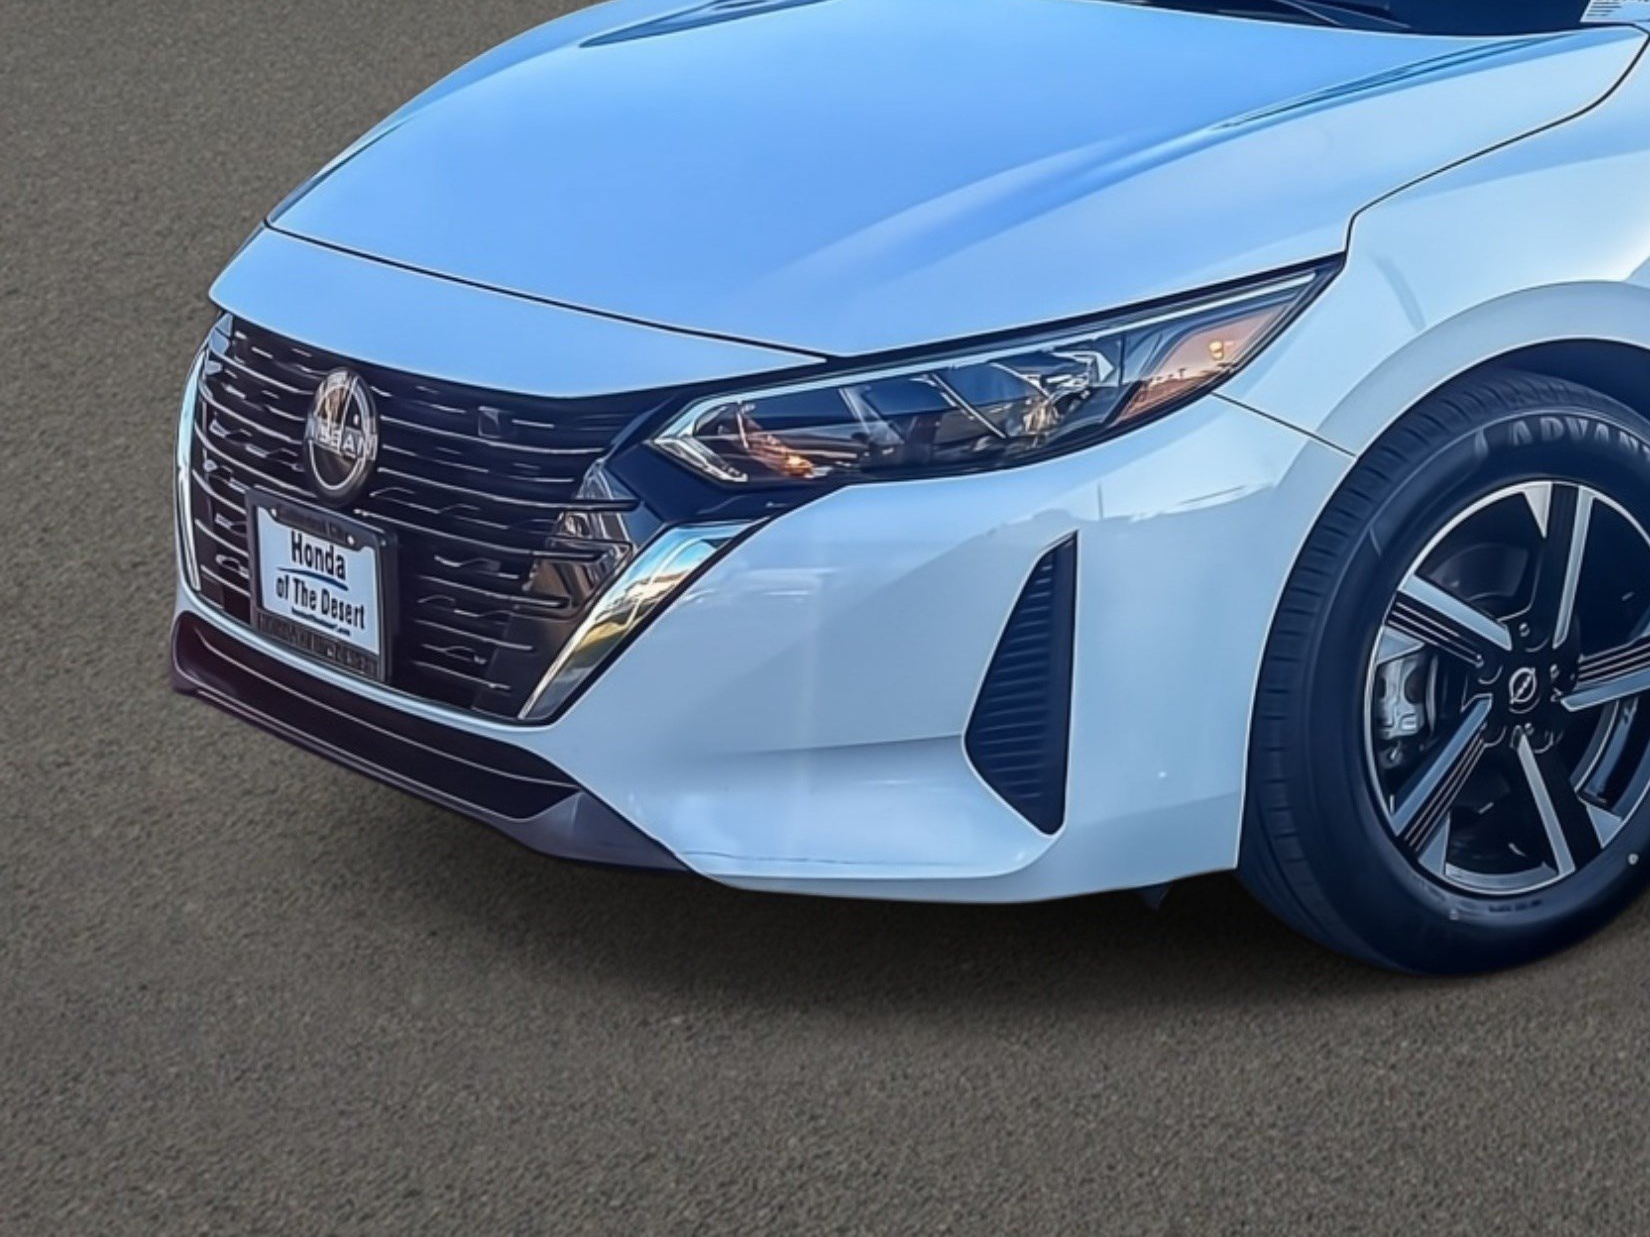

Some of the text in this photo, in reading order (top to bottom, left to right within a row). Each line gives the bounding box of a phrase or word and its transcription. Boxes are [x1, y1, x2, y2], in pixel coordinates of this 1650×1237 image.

[290, 529, 346, 582] Honda
[275, 574, 290, 601] of
[292, 576, 318, 612] The
[321, 587, 365, 631] Desert
